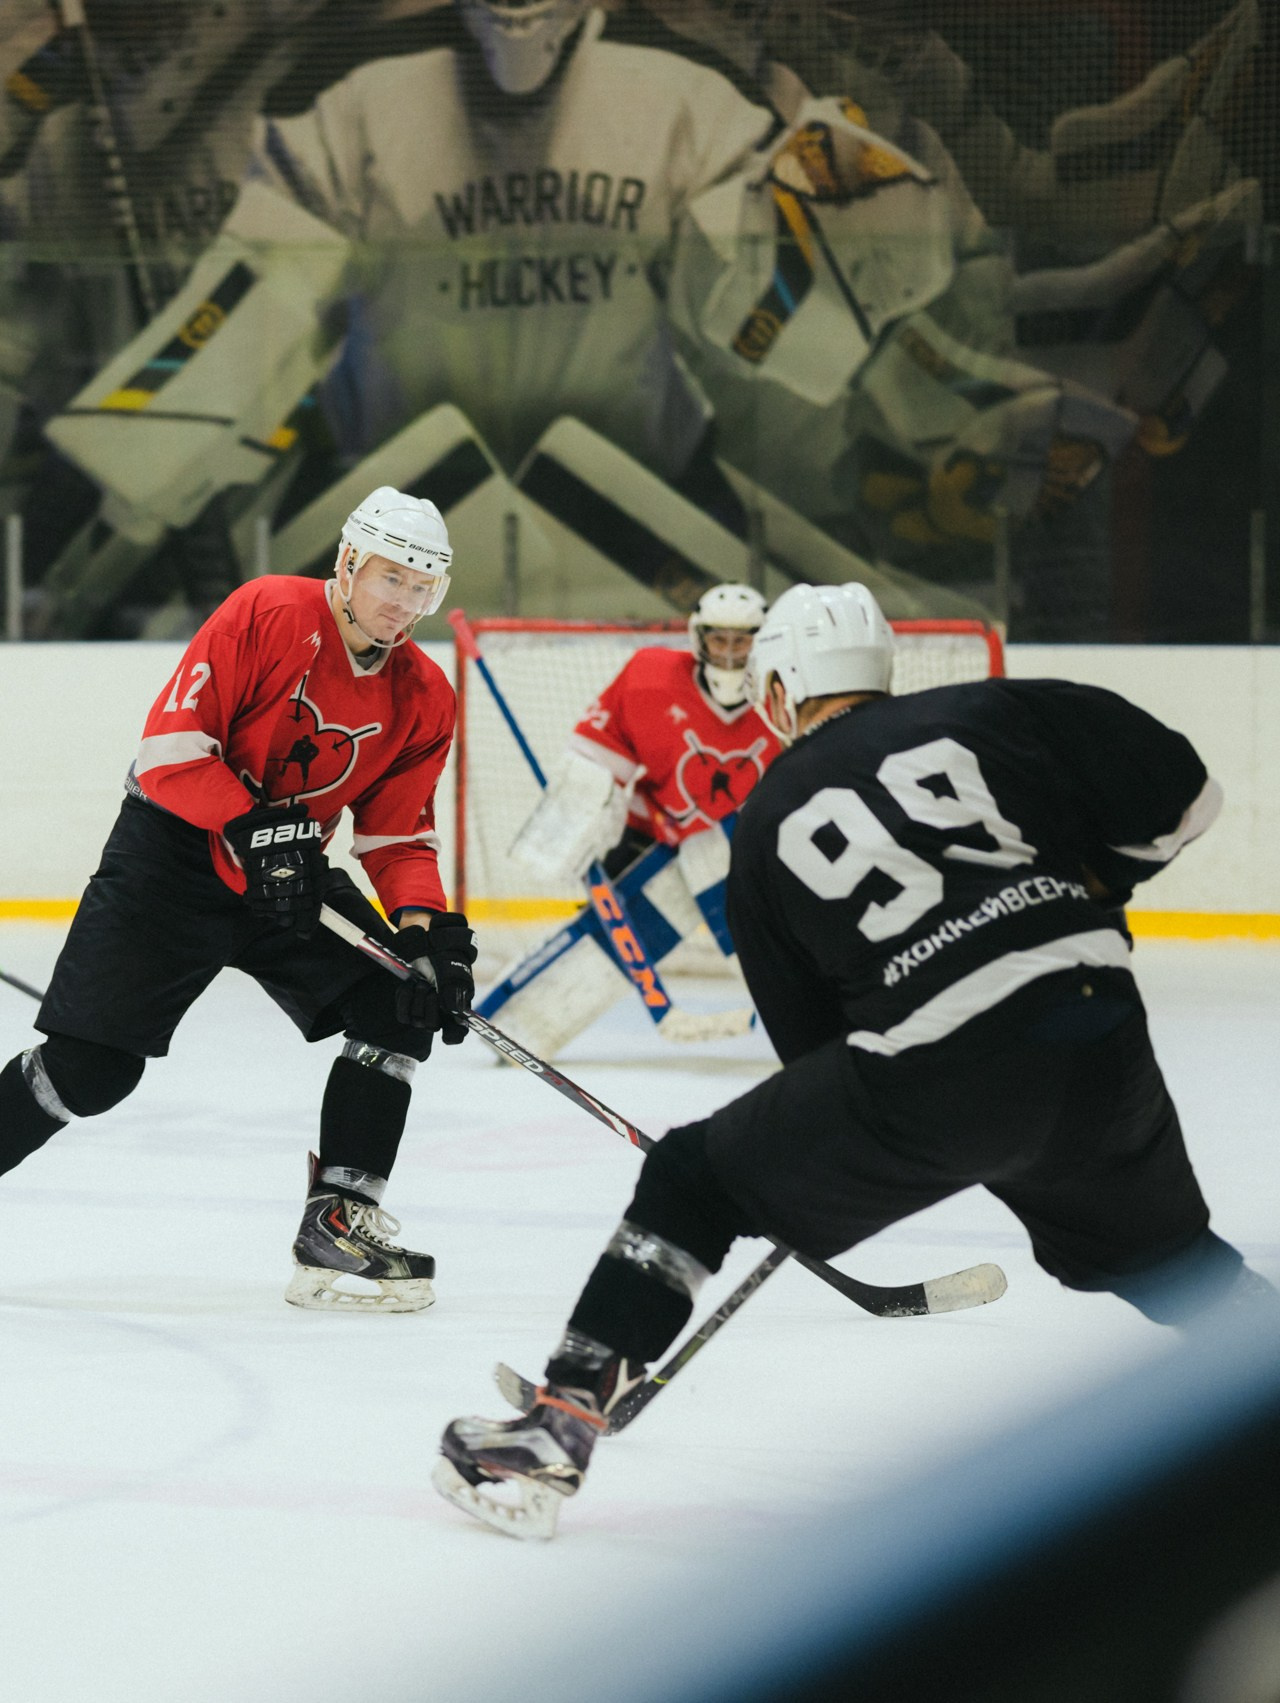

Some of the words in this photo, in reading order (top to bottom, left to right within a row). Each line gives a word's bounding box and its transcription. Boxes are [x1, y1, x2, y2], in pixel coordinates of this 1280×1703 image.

[434, 167, 646, 241] WARRIOR
[460, 254, 616, 312] HOCKEY
[163, 662, 211, 712] 12
[777, 737, 1038, 943] 99
[591, 884, 668, 1007] CCM
[468, 1016, 544, 1074] SPEED
